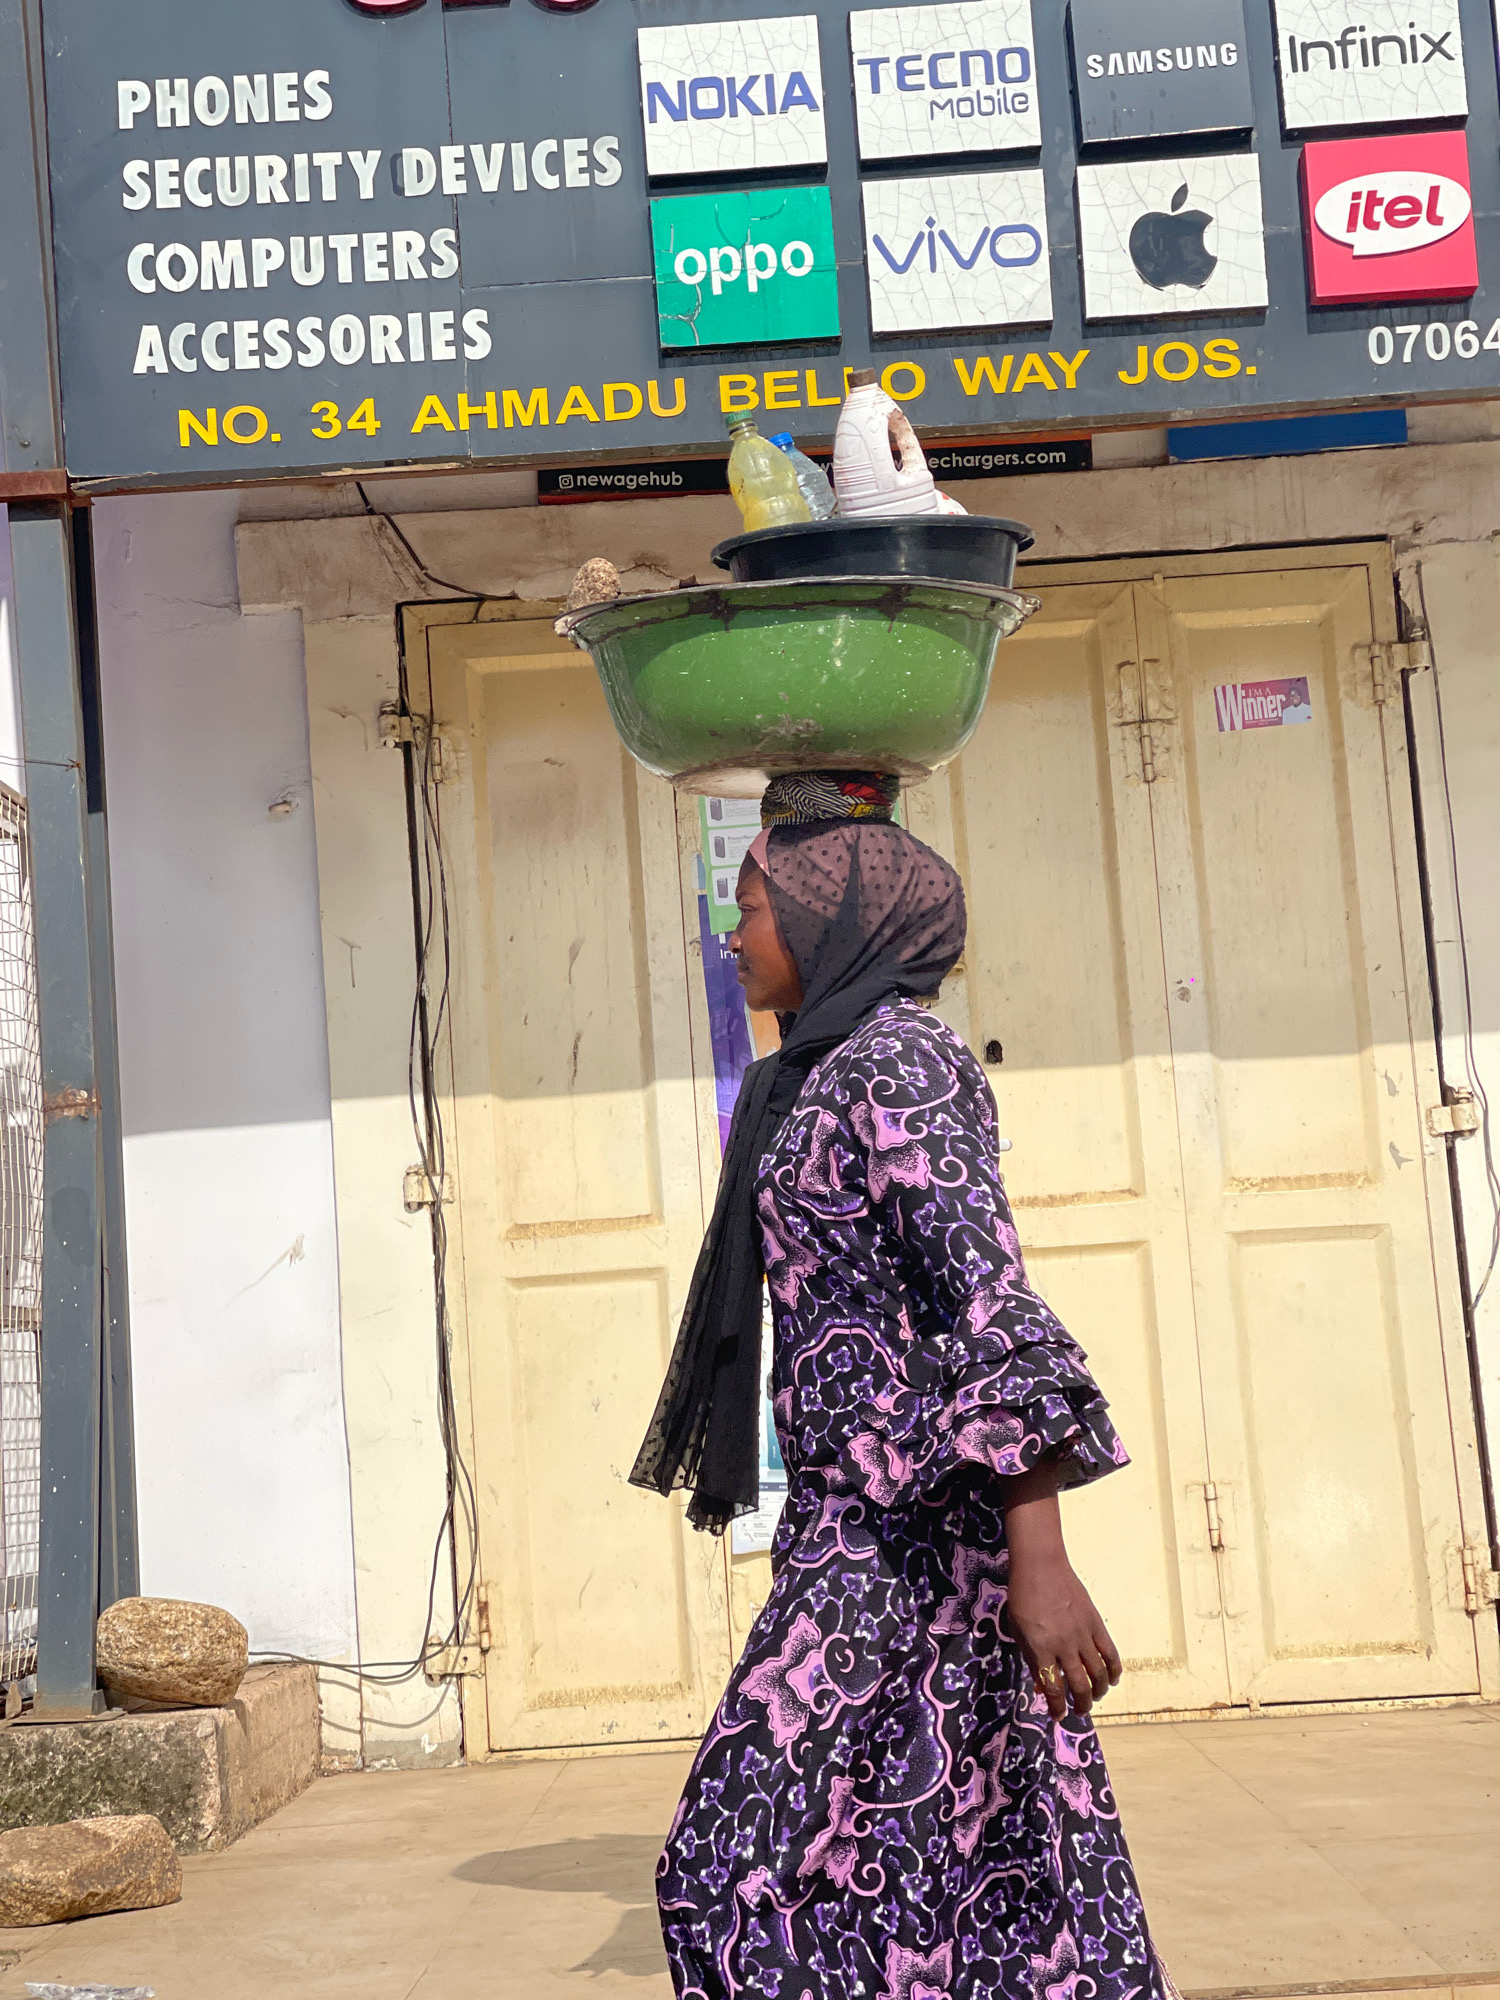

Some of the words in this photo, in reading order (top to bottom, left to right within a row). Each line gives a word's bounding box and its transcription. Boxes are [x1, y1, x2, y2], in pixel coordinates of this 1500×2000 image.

[857, 46, 1031, 94] TECNO
[1086, 42, 1238, 78] SAMSUNG
[1288, 21, 1455, 73] Infinix
[117, 69, 333, 130] PHONES
[646, 71, 820, 123] NOKIA
[930, 91, 1029, 121] Mobile
[122, 149, 382, 211] SECURITY
[401, 135, 623, 197] DEVICES
[1346, 185, 1444, 233] itel
[126, 227, 459, 294] COMPUTERS
[674, 240, 814, 296] oppo
[872, 216, 1042, 274] vivo
[132, 308, 492, 374] ACCESSORIES
[178, 405, 281, 447] NO.
[310, 397, 381, 439] 34
[411, 377, 686, 434] AHMADU
[719, 361, 926, 413] BELO
[953, 349, 1090, 396] WAY
[1117, 338, 1257, 385] JOS.
[576, 471, 683, 489] newagehub
[1215, 683, 1286, 732] Winner
